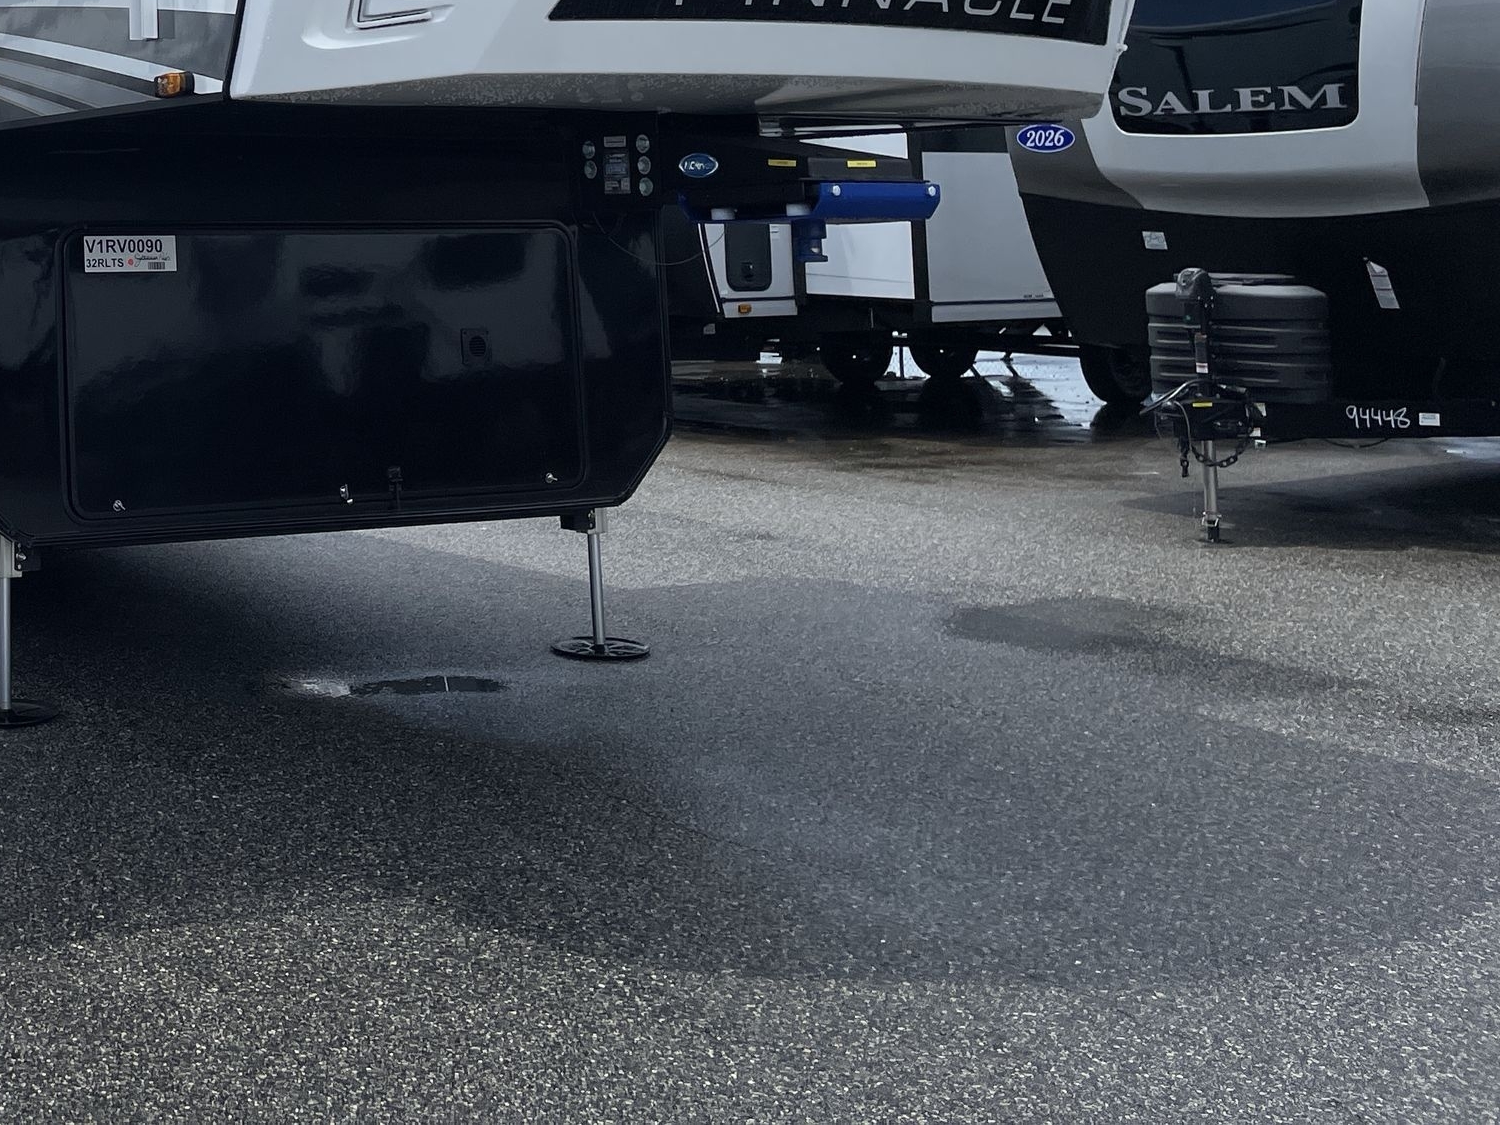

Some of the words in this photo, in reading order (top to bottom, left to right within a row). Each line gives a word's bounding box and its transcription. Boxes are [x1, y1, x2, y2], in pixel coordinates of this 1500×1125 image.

[1117, 83, 1348, 117] SALEM
[1026, 129, 1065, 147] 2026
[85, 239, 163, 254] V1RV0090
[86, 258, 124, 268] 32RLTS
[1345, 405, 1411, 429] 94448
